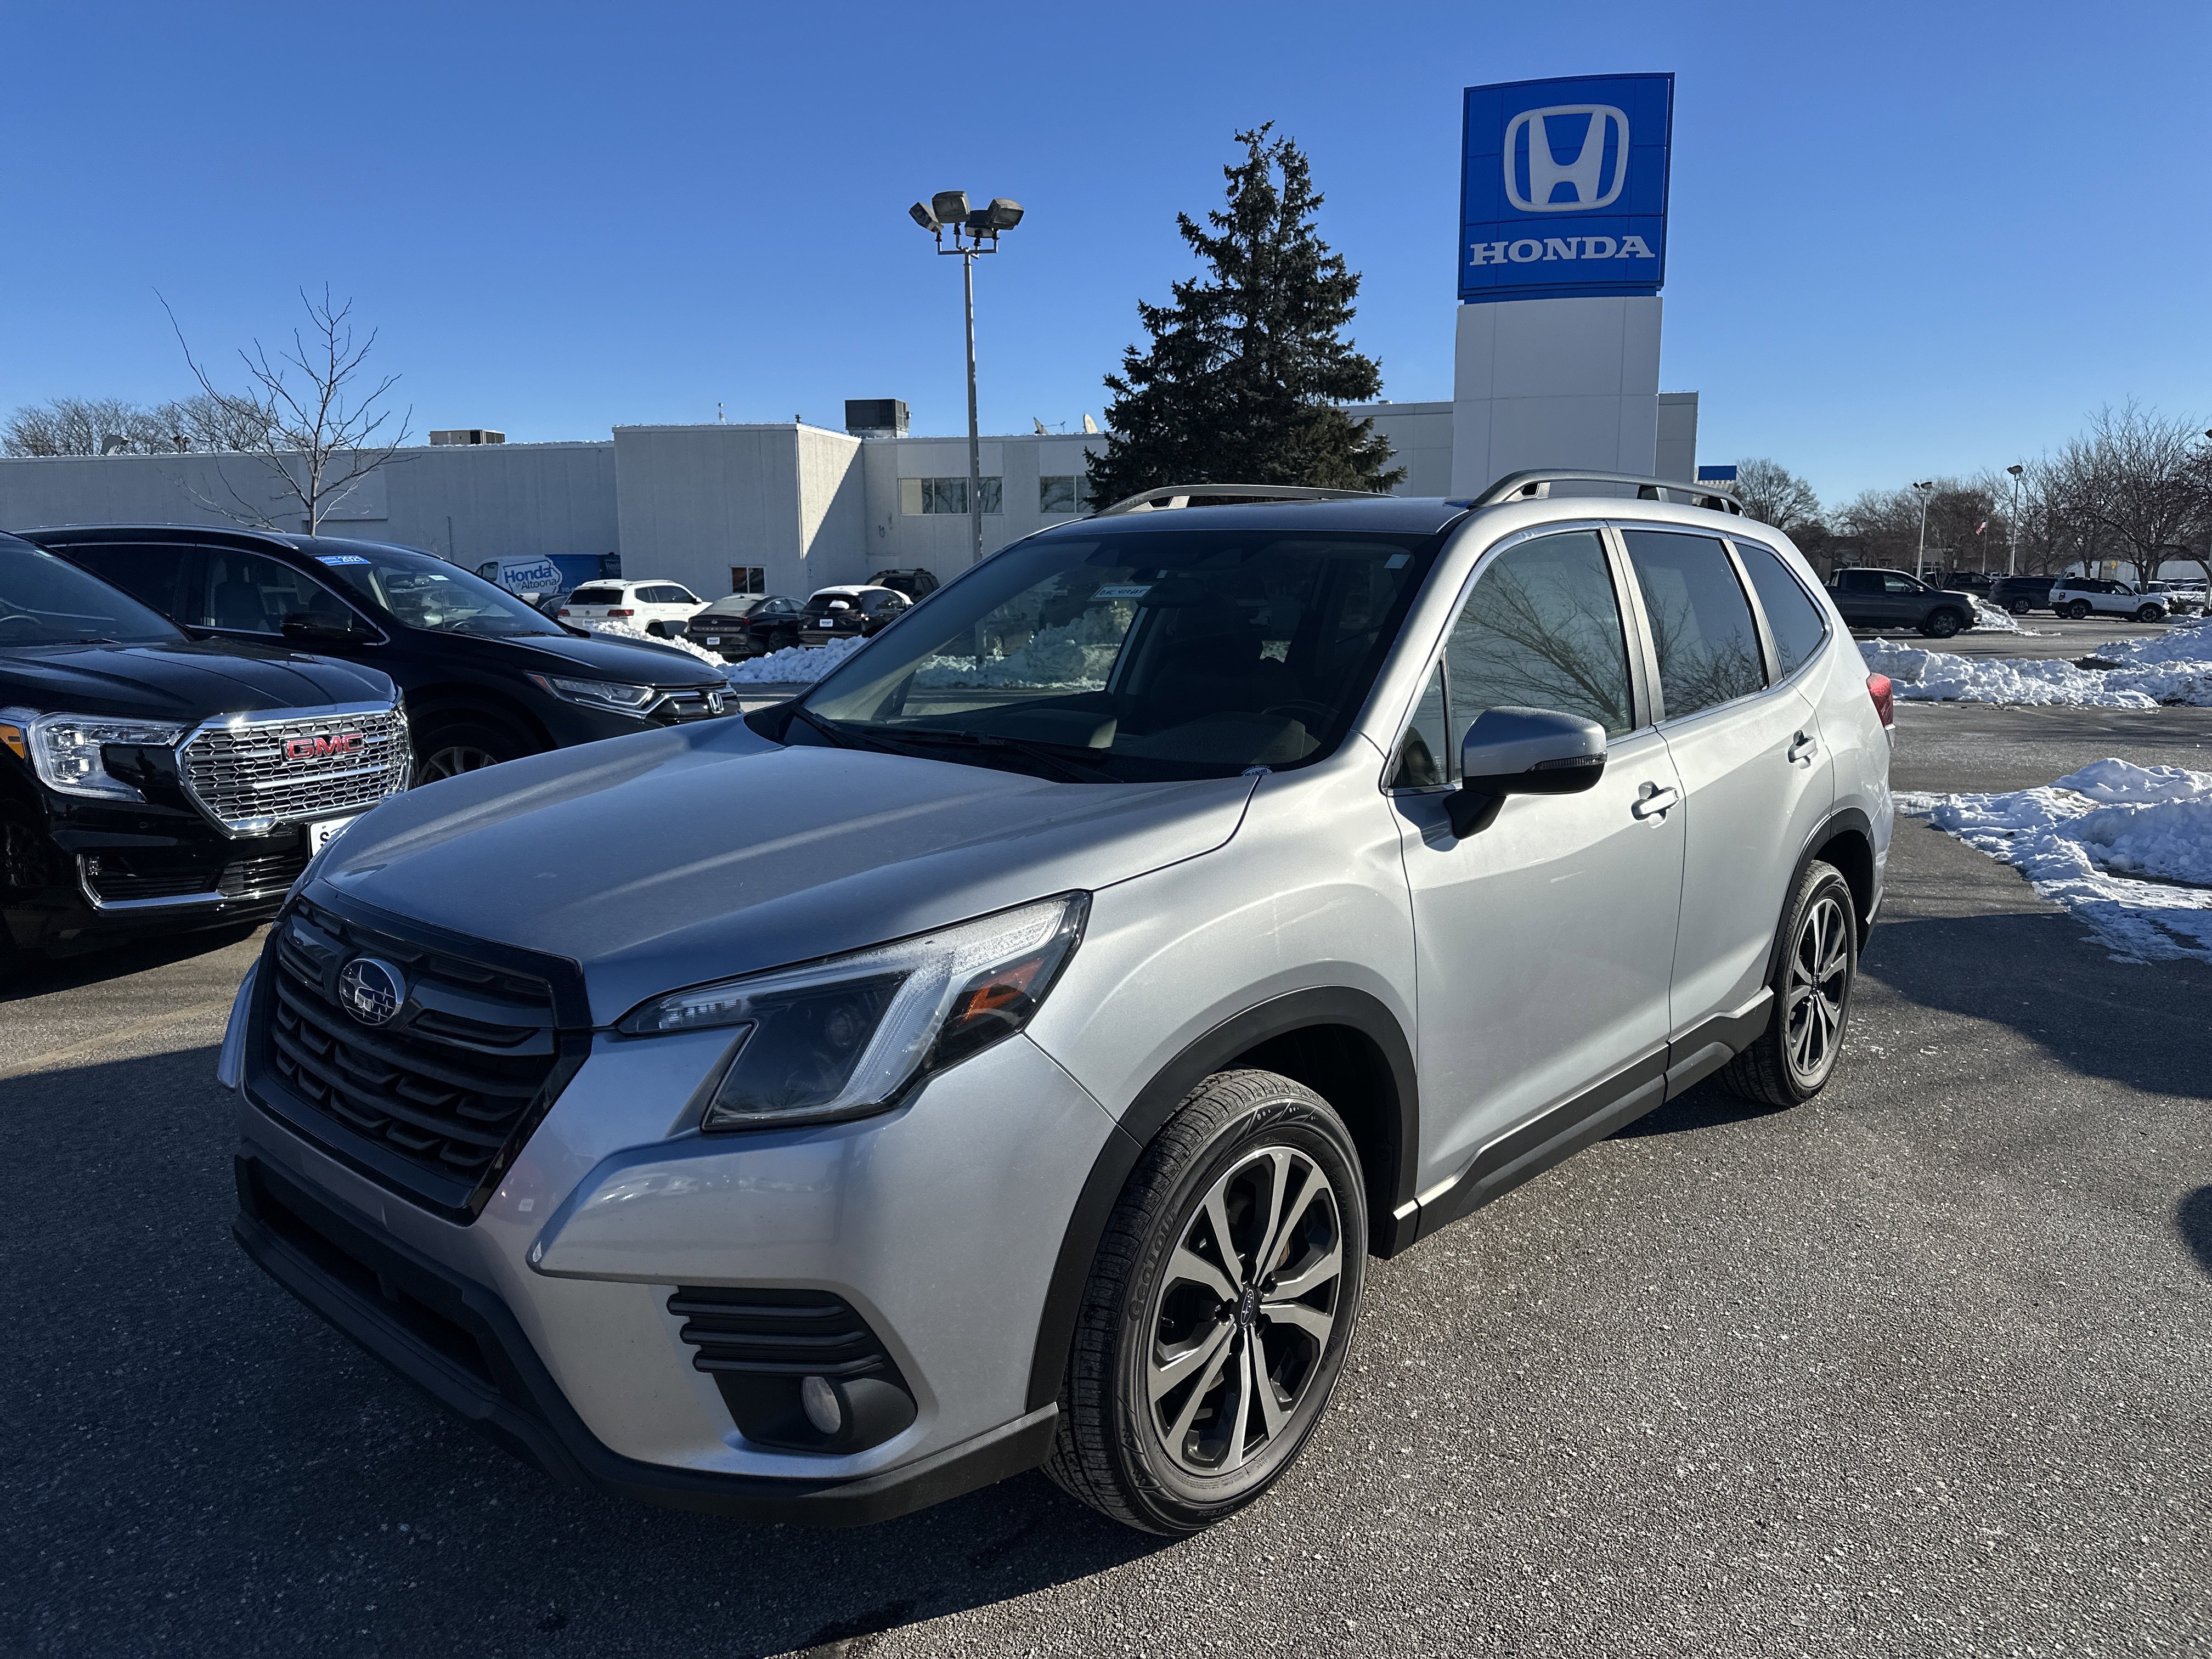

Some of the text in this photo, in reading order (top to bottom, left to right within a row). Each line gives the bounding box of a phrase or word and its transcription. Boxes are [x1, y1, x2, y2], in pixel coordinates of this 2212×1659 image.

[1469, 235, 1655, 266] HONDA
[504, 565, 552, 583] Honda
[521, 578, 557, 590] Altoona
[286, 733, 366, 759] GMC
[1197, 1505, 1234, 1516] OUTSIDE
